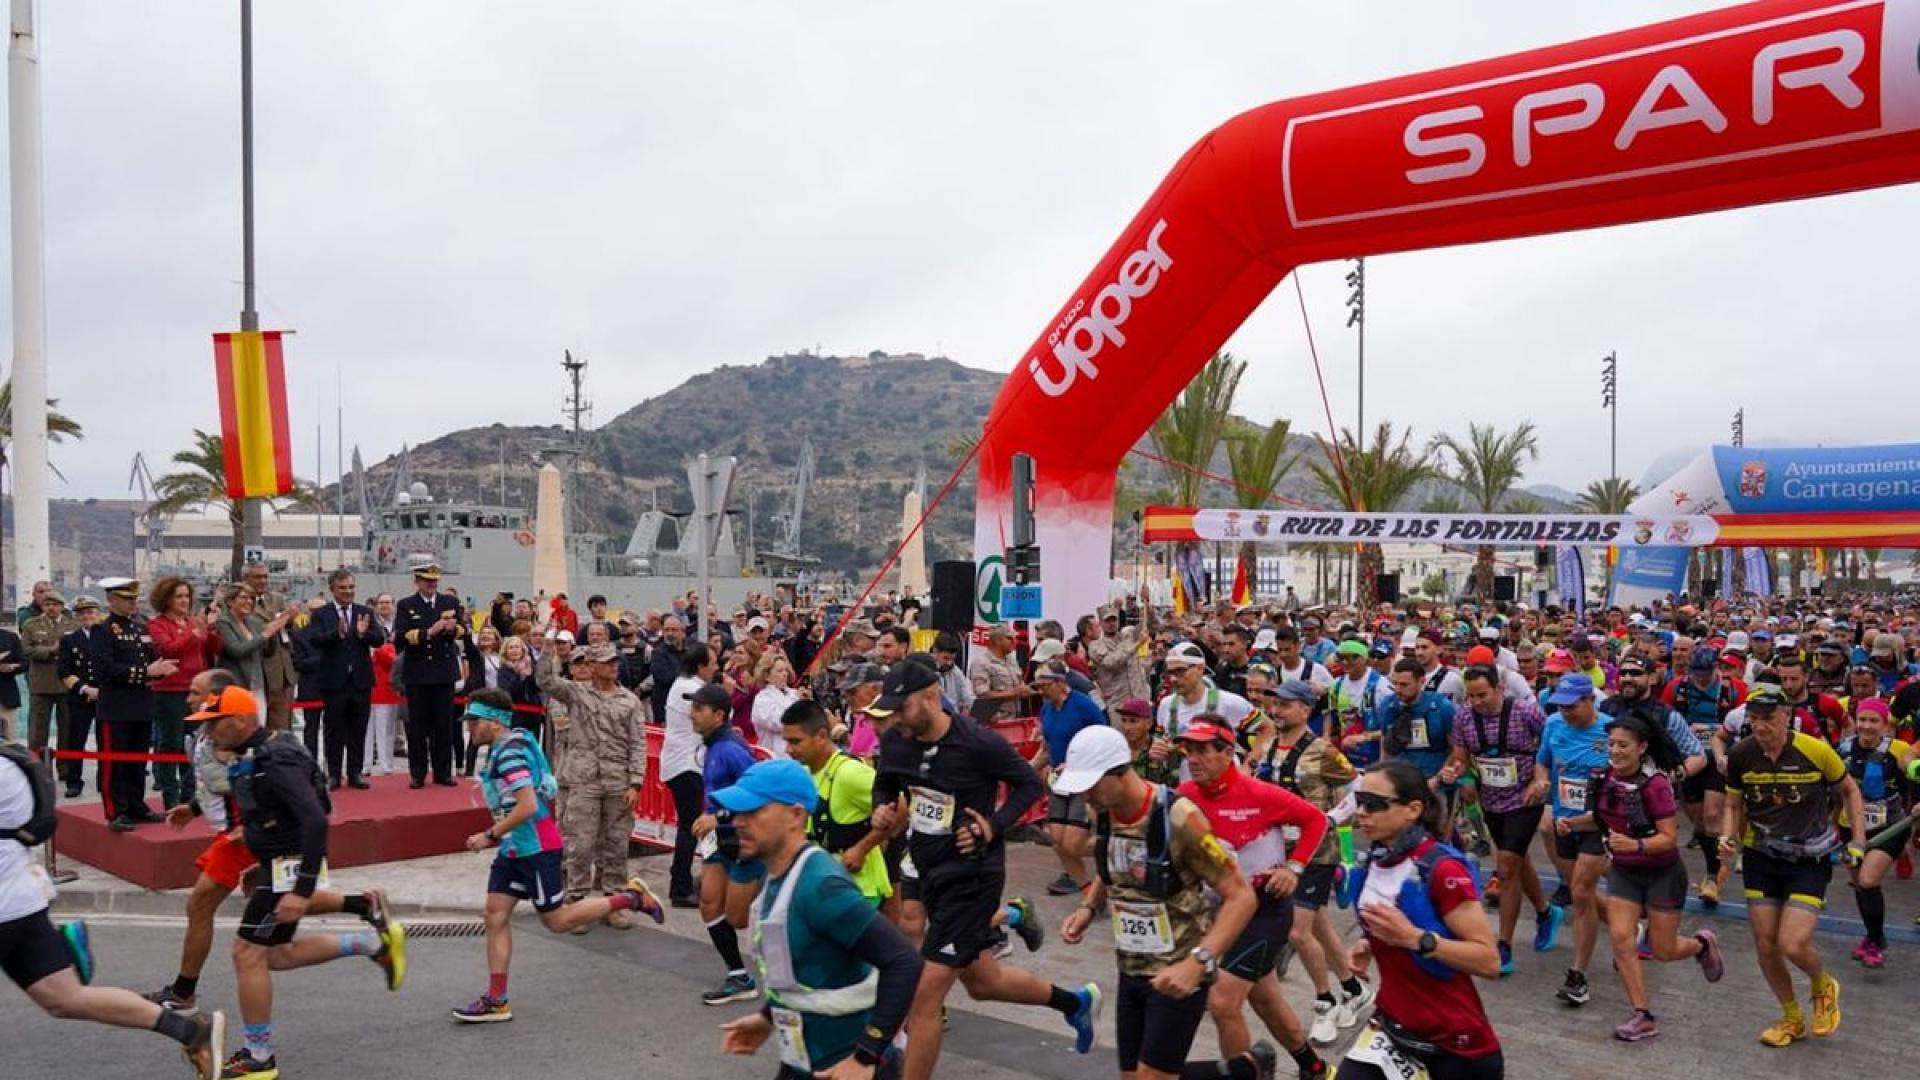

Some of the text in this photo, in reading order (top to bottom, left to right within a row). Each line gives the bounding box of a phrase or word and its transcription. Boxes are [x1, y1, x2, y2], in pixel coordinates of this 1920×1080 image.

[1402, 28, 1865, 186] SPAR
[1047, 298, 1085, 346] grupo
[1783, 477, 1920, 501] Cartagena
[1280, 516, 1622, 542] RUTA DE LAS FORTALEZAS
[1120, 917, 1157, 936] 3261
